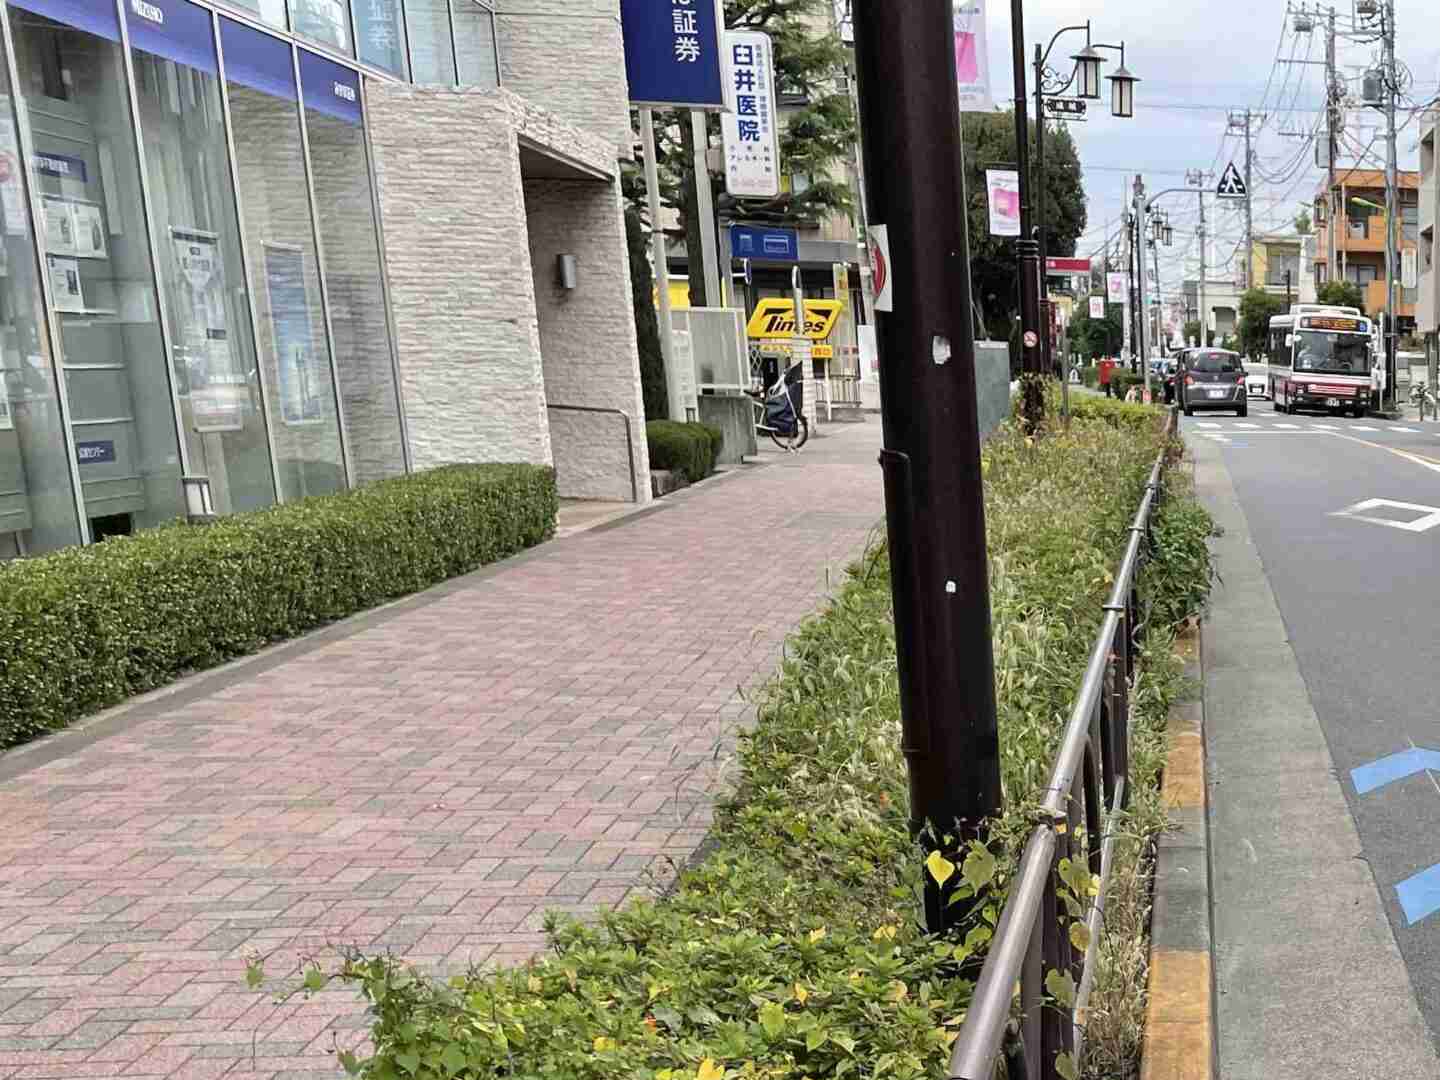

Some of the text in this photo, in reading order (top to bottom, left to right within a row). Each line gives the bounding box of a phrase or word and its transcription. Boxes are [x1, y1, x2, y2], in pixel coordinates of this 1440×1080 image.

[671, 0, 701, 62] 証券
[733, 44, 760, 142] 臼井医院
